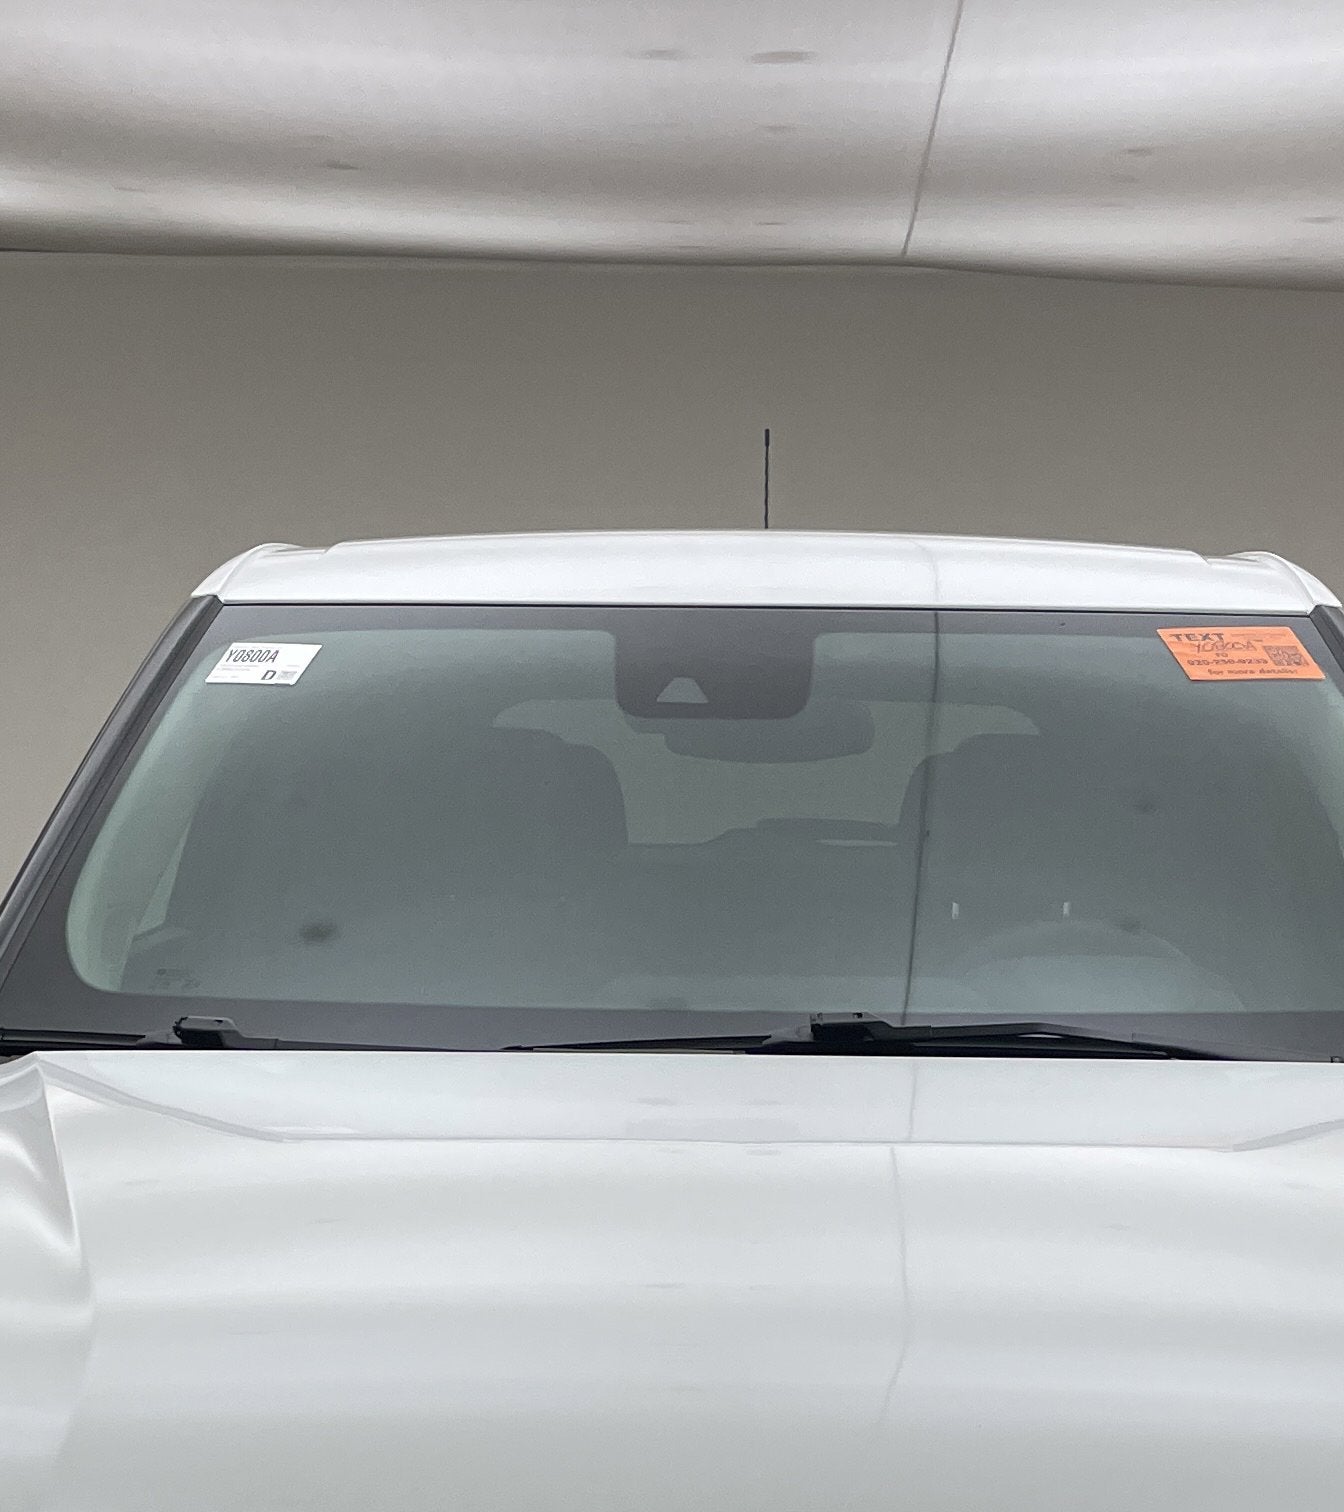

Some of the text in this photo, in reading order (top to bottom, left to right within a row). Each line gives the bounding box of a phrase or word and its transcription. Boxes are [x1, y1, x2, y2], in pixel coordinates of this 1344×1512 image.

[1169, 632, 1224, 642] TEXT
[225, 649, 280, 663] Y0800A
[261, 669, 277, 681] D
